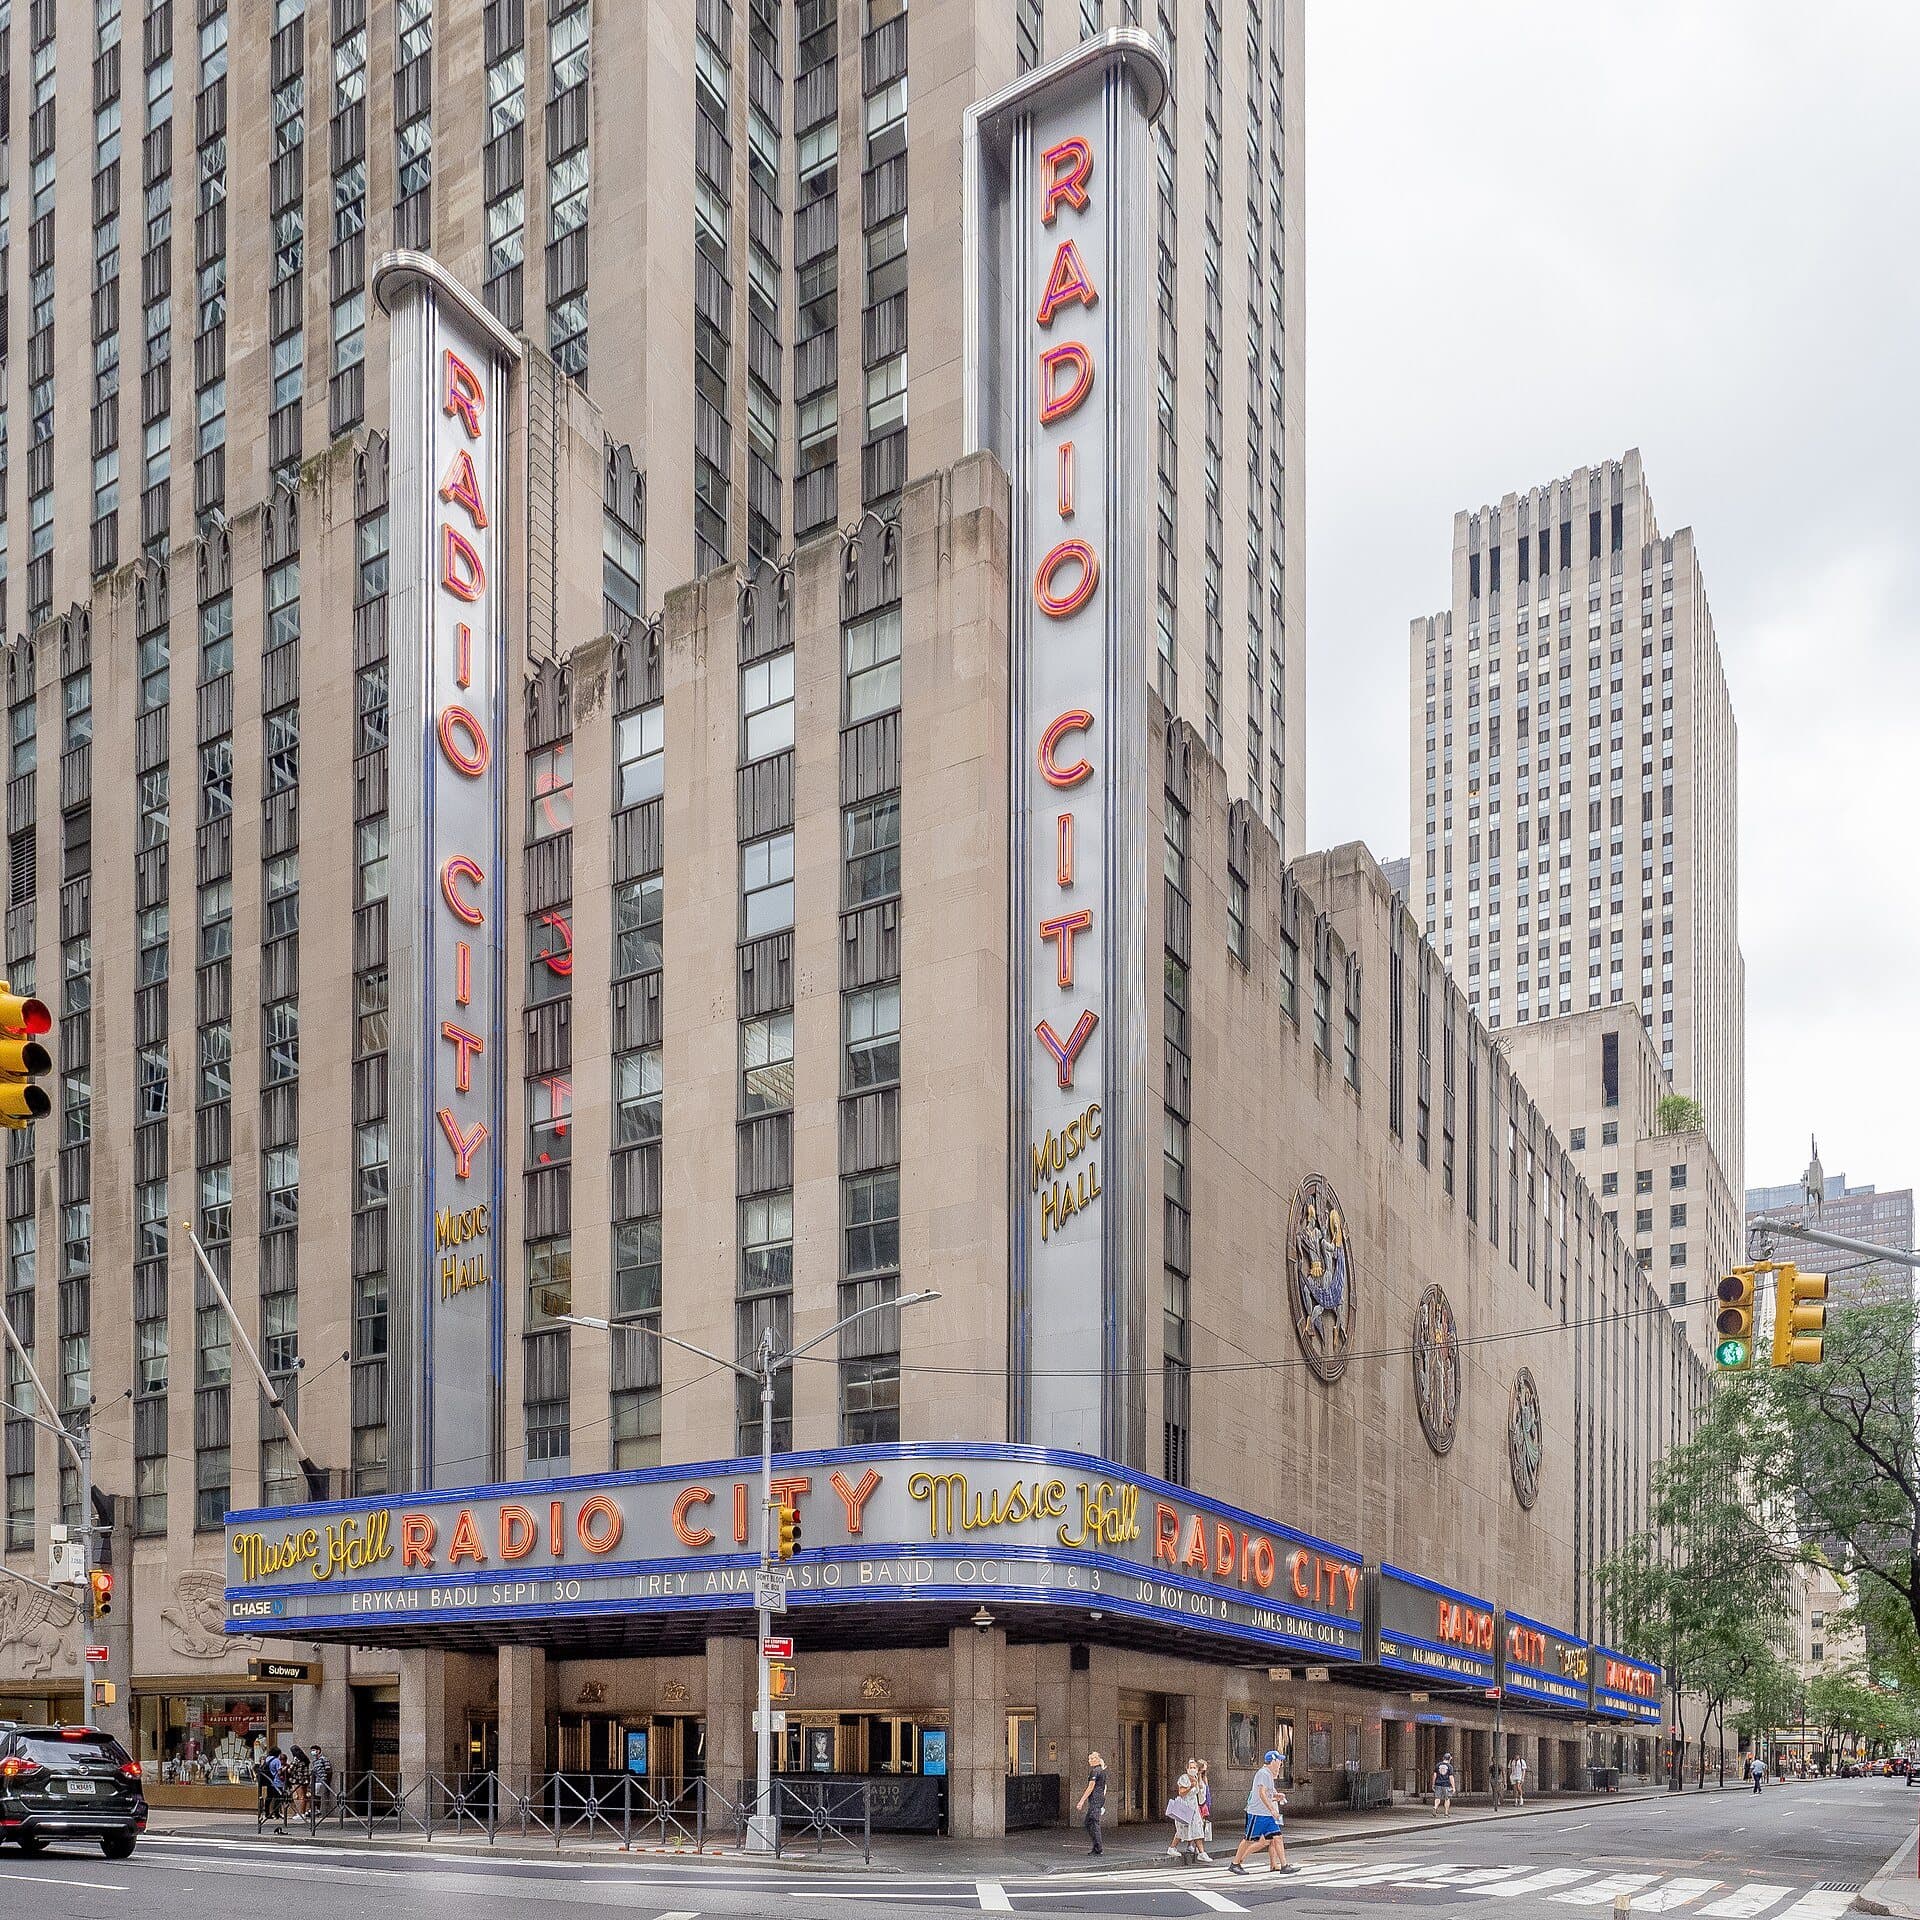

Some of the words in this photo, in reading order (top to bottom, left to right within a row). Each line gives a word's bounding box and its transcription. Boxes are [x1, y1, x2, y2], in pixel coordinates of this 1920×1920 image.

[1034, 135, 1100, 618] RADIO
[438, 347, 489, 777] RADIO
[1034, 708, 1099, 1089] CITY
[436, 854, 488, 1179] CITY
[1032, 1102, 1101, 1192] MUSIC
[1040, 1162, 1101, 1241] HALL
[435, 1205, 488, 1252] MUSIC
[441, 1254, 488, 1300] HALL
[402, 1495, 624, 1569] RADIO
[672, 1467, 883, 1546] CITY
[908, 1471, 1067, 1538] Music
[1058, 1481, 1141, 1548] Hall
[232, 1527, 320, 1582] Music
[311, 1508, 393, 1582] Hall
[1156, 1501, 1274, 1589] RADIO
[1288, 1550, 1360, 1611] CITY
[352, 1591, 418, 1612] ERYKAH
[431, 1587, 478, 1607] BADU
[492, 1582, 537, 1604] SEPT
[554, 1580, 581, 1601] 30
[635, 1573, 688, 1595] TREY
[705, 1564, 841, 1592] ANAASIO
[860, 1561, 933, 1584] BAND
[955, 1560, 1016, 1583] OCT
[1038, 1564, 1052, 1585] 2
[1091, 1569, 1101, 1590] 3
[1136, 1581, 1153, 1602] JO
[1160, 1585, 1184, 1609] KOY
[1191, 1593, 1214, 1617] OCT
[1221, 1600, 1228, 1618] 8
[233, 1601, 271, 1616] CHASE
[1251, 1609, 1282, 1632] JAMES
[1287, 1615, 1313, 1637] BLAKE
[1317, 1624, 1335, 1642] OCT
[1338, 1627, 1345, 1645] 9
[1438, 1601, 1493, 1649] RADIO
[1380, 1641, 1396, 1655] CHASE
[1413, 1648, 1445, 1668] ALEJANDRO
[1512, 1625, 1546, 1666] CITY
[268, 1665, 300, 1678] Subway
